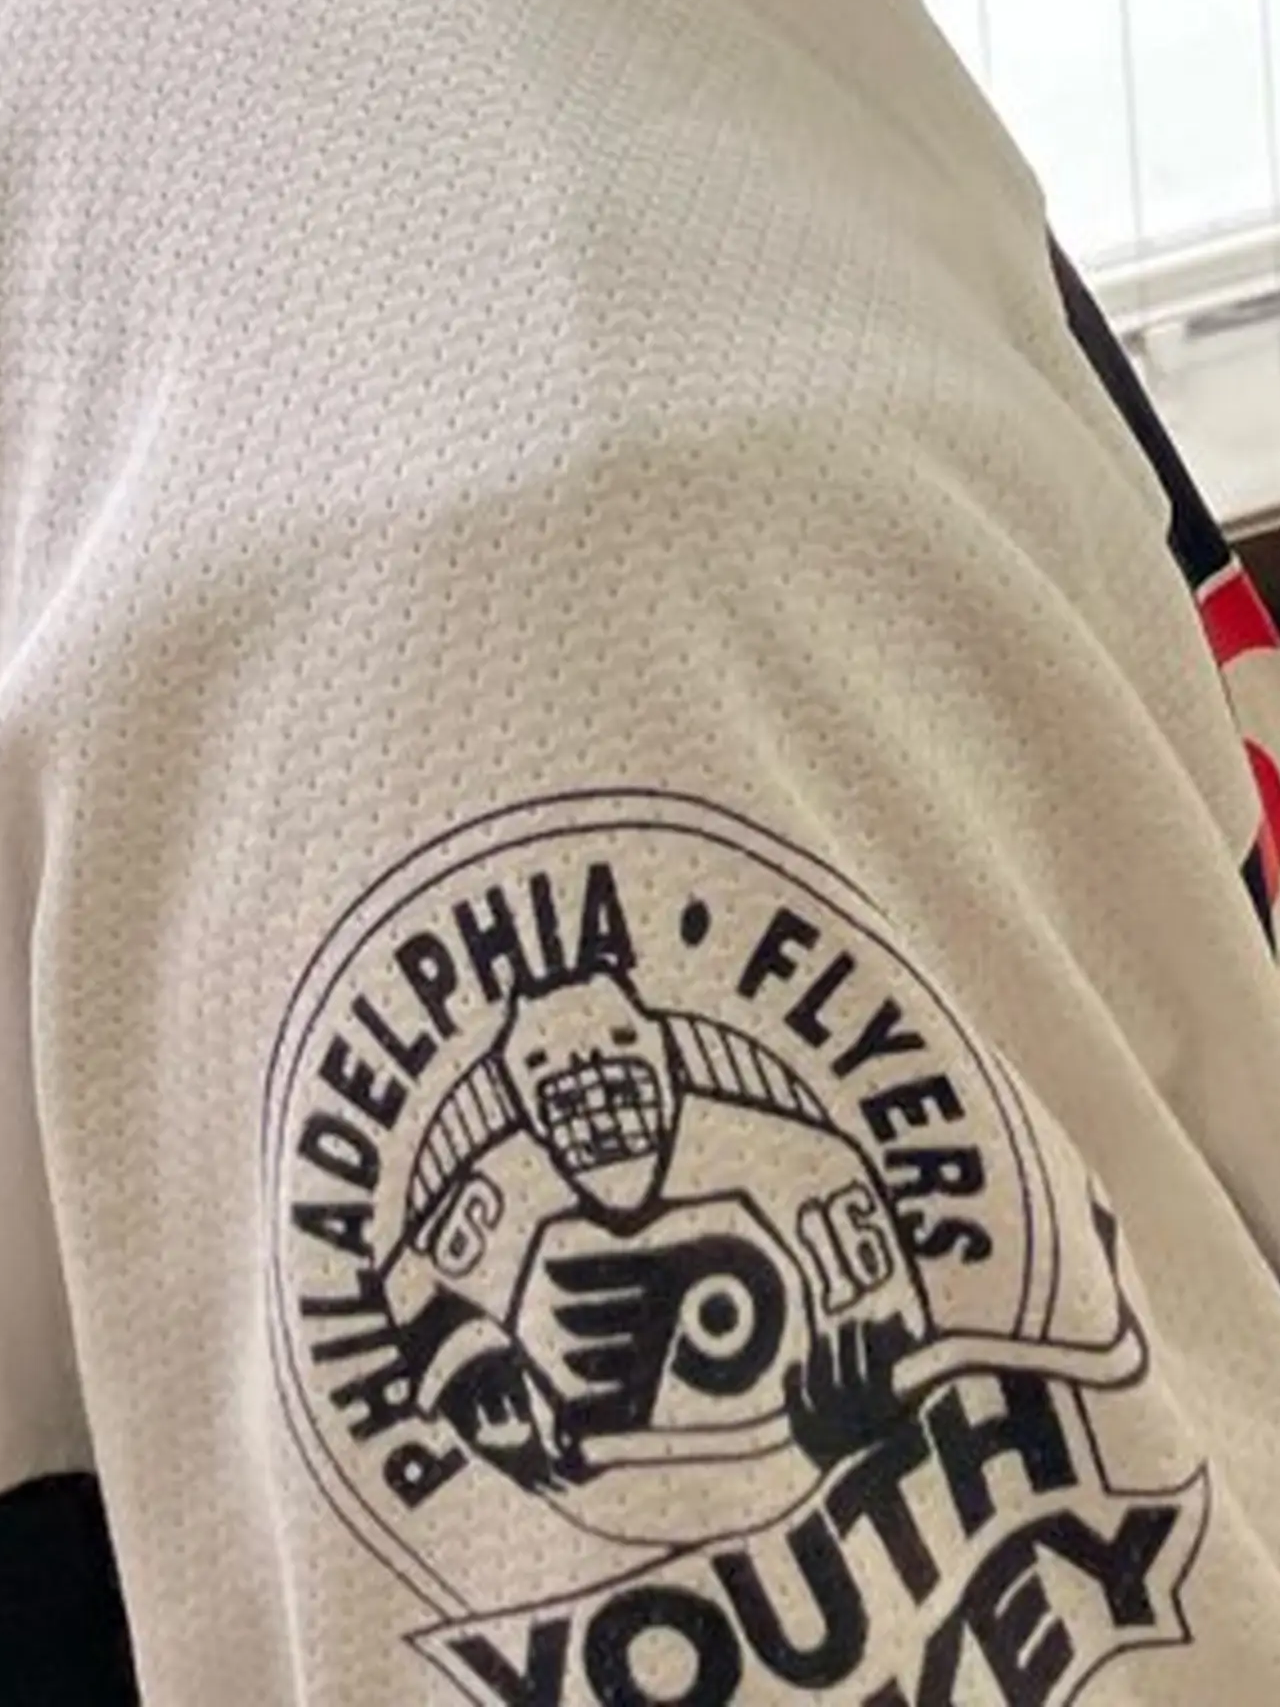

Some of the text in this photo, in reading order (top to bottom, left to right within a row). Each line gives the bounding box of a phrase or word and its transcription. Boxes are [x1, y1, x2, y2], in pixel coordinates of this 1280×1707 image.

[291, 862, 993, 1510] PHILADELPHIA FLYERS
[795, 1179, 894, 1316] 16
[448, 1373, 1078, 1707] YOUTH
